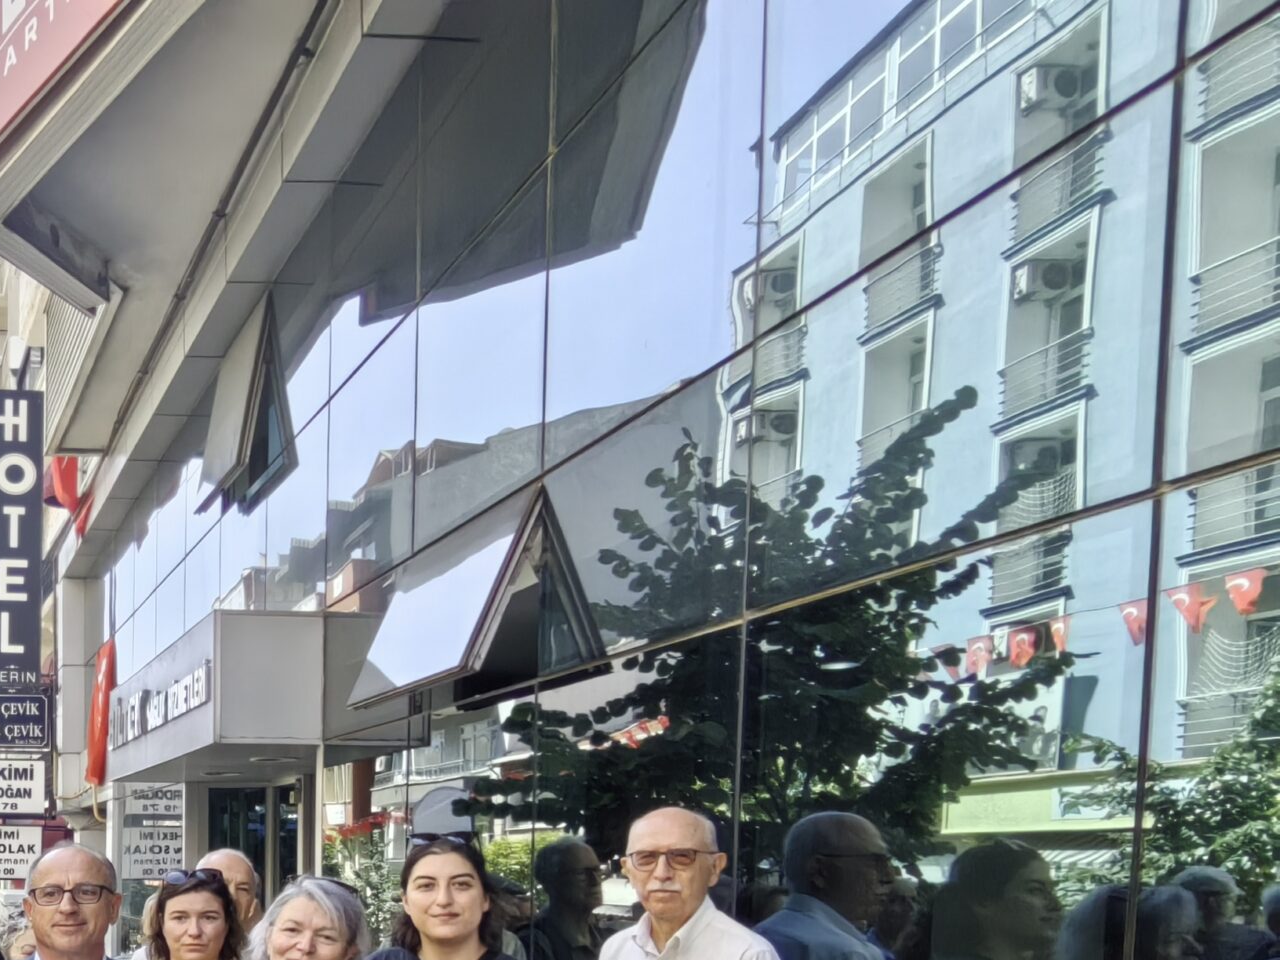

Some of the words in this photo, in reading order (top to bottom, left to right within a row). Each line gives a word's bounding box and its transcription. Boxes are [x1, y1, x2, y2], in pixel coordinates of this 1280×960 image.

[1, 701, 39, 719] ÇEVİK
[4, 723, 42, 740] ÇEVİK
[1, 803, 18, 811] 78
